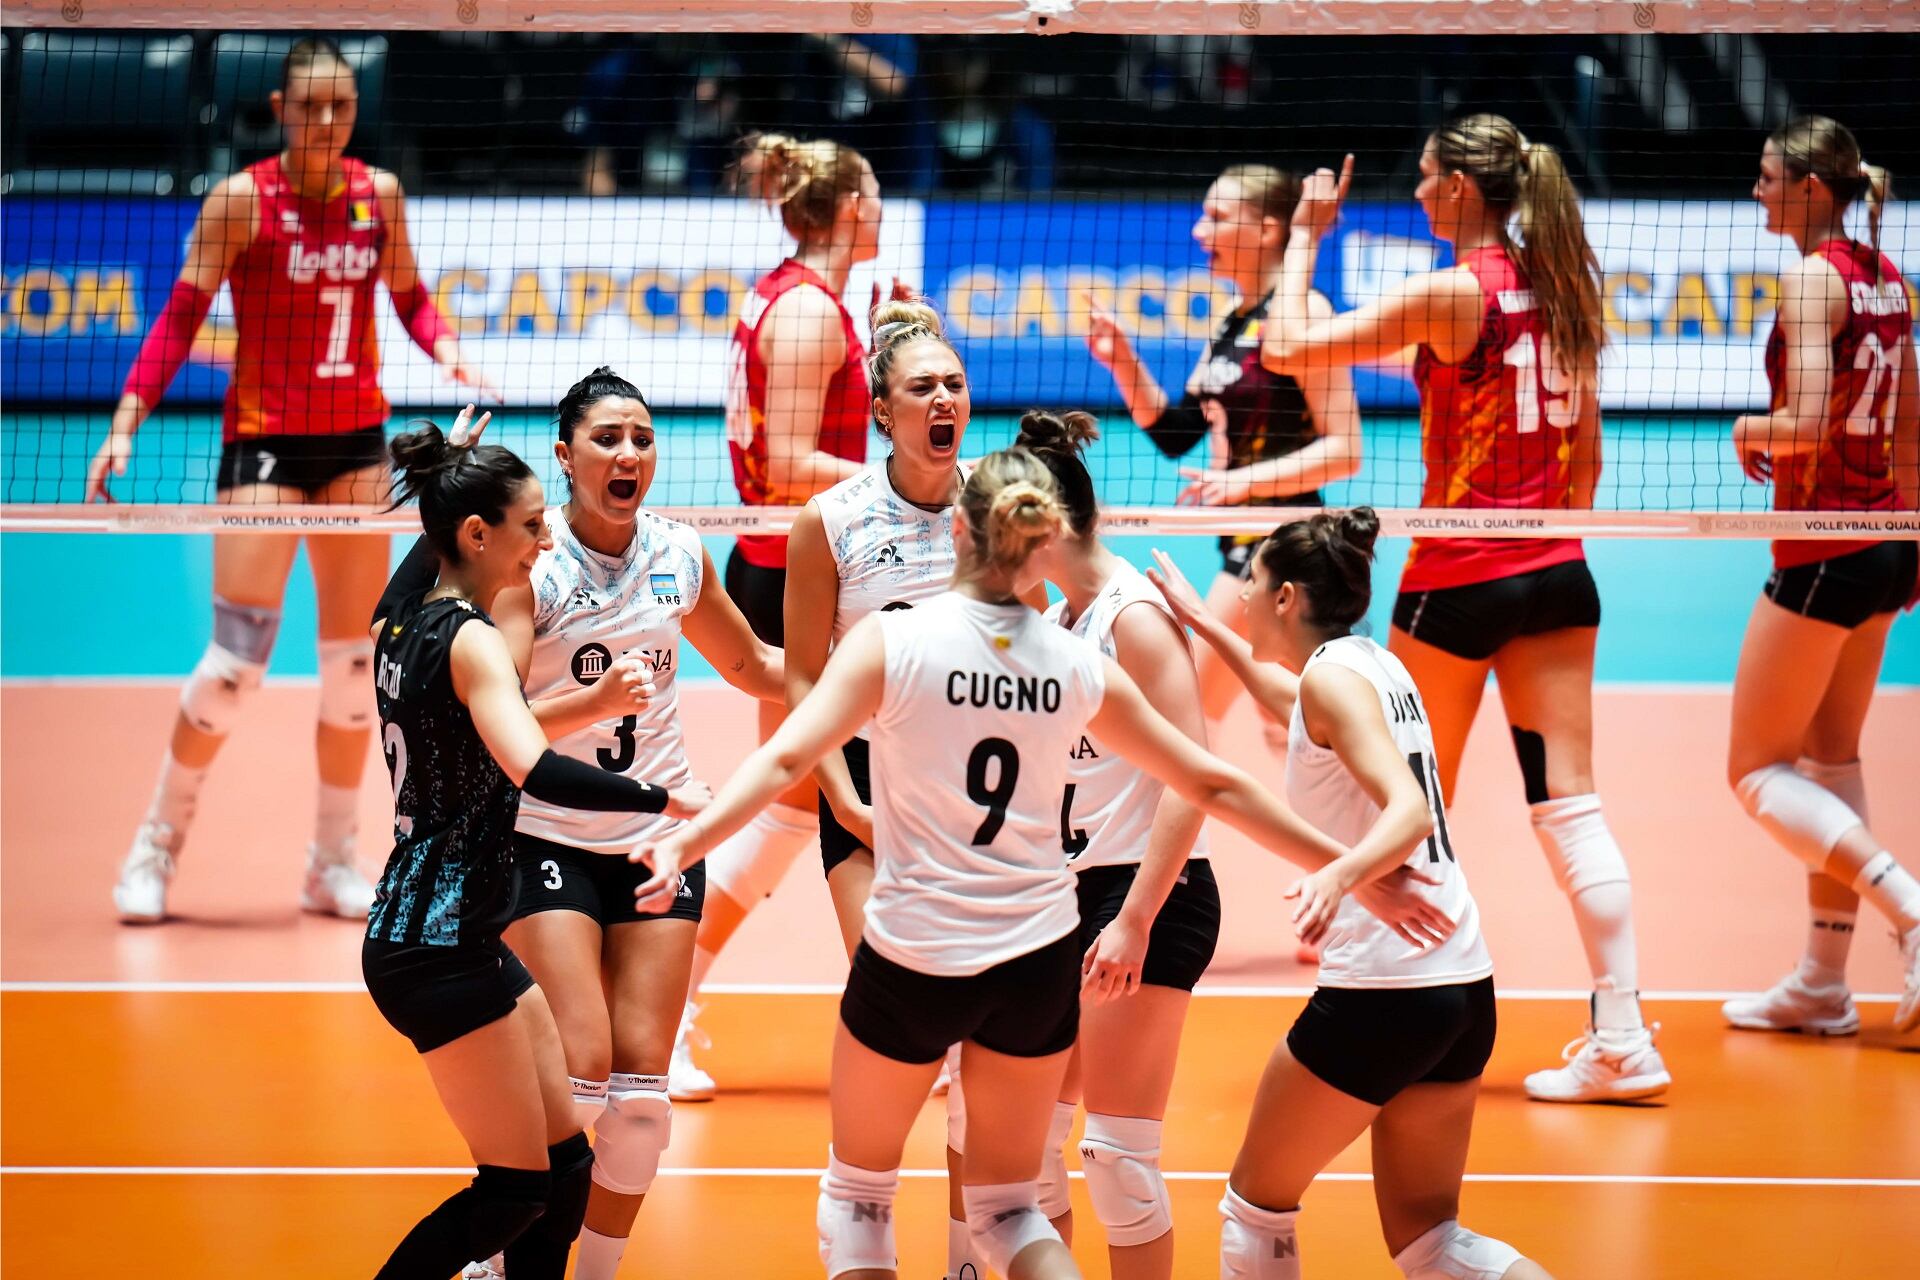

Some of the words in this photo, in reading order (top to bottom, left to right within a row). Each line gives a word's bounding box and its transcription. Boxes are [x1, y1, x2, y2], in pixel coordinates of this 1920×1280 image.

[1, 268, 137, 335] OM
[437, 270, 748, 334] CAPCO
[950, 271, 1228, 338] CAPCO
[1604, 271, 1780, 336] CAP
[257, 451, 278, 481] 7
[221, 515, 296, 526] VOLLEYBALL
[300, 516, 360, 526] QUALIFIER
[699, 517, 759, 527] QUALIFIER
[1404, 518, 1480, 529] VOLLEYBALL
[1483, 519, 1544, 529] QUALIFIER
[1805, 520, 1881, 531] VOLLEYBALL
[657, 595, 681, 605] ARG
[622, 649, 672, 672] NA
[947, 671, 1061, 714] CUGNO
[596, 714, 637, 773] 3
[379, 716, 415, 838] 2
[966, 737, 1020, 846] 9
[540, 860, 563, 890] 3
[1081, 1148, 1096, 1160] N1
[1273, 1236, 1296, 1259] N
